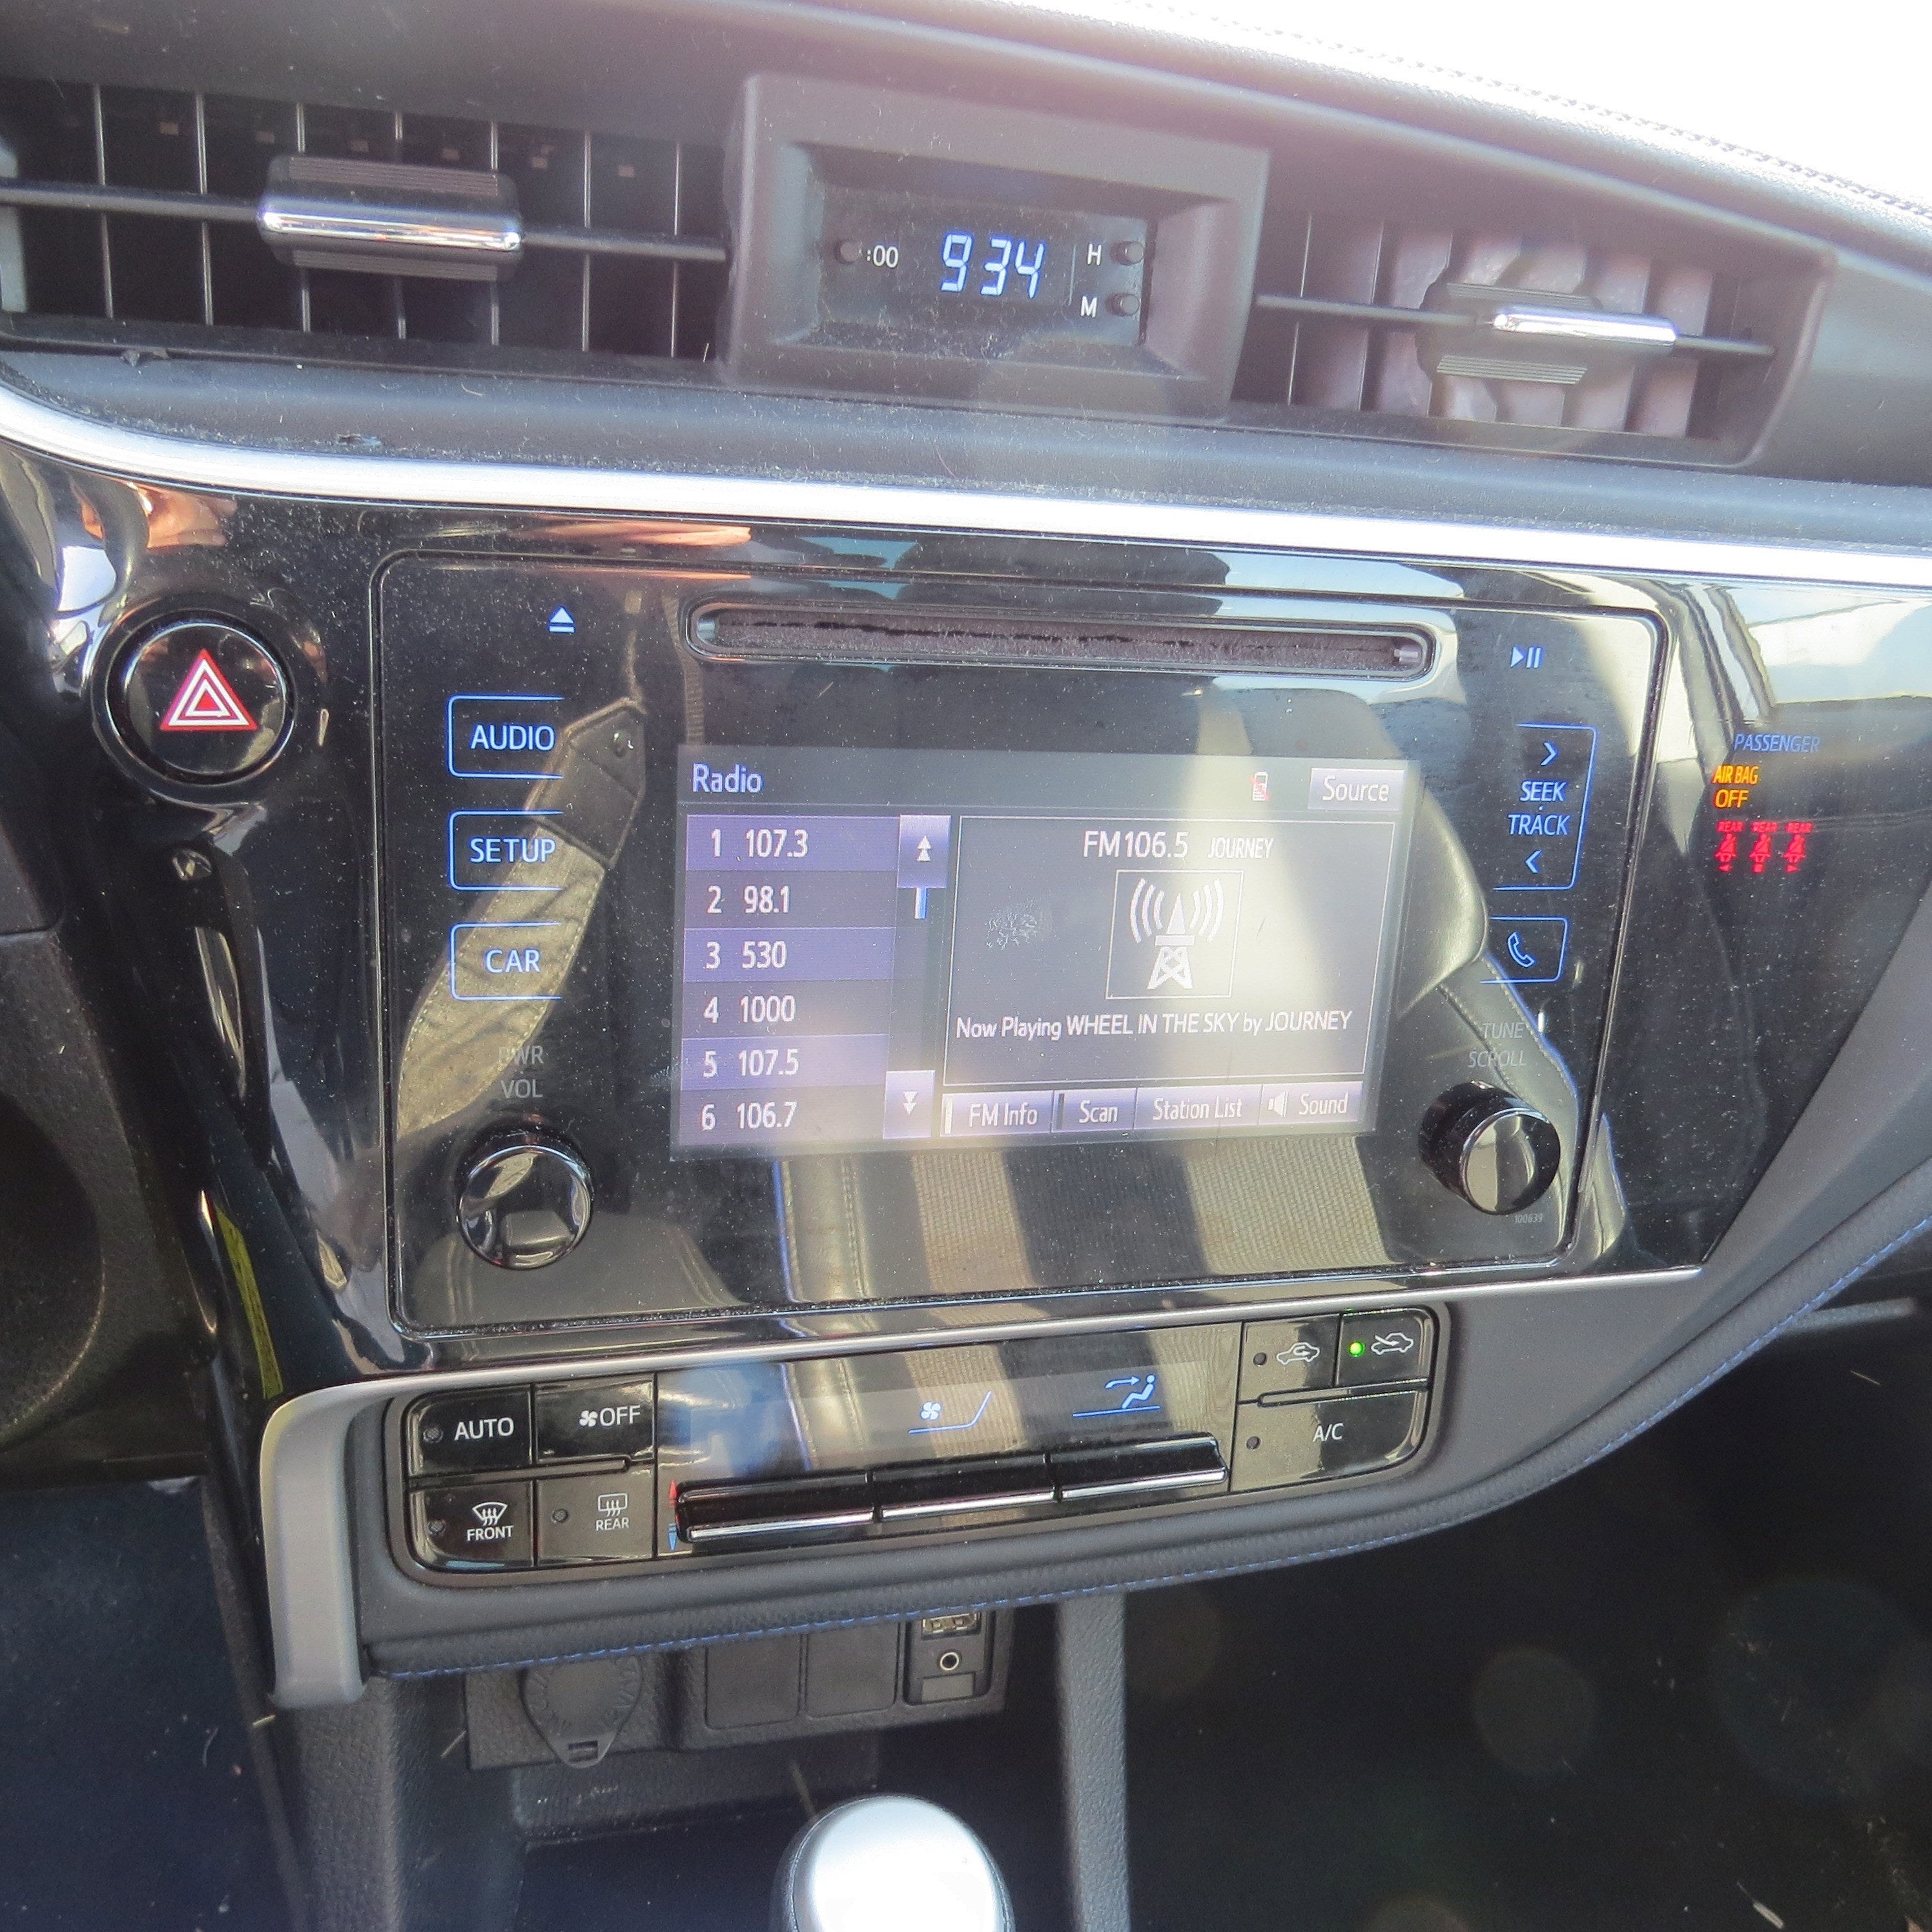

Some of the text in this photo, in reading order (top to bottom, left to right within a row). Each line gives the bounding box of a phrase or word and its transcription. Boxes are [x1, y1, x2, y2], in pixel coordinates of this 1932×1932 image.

[866, 244, 899, 268] :00
[1087, 243, 1102, 265] H
[1080, 296, 1097, 318] M
[470, 724, 555, 751] AUDIO
[1734, 734, 1821, 752] PASSENGER
[692, 763, 764, 793] Radio
[1712, 765, 1760, 785] AIR BAG
[1322, 774, 1390, 802] Source
[1519, 780, 1567, 802] SEEK
[1714, 789, 1749, 808] OFF
[1508, 814, 1570, 836] TRACK
[470, 838, 556, 863] SETUP
[711, 828, 808, 858] 1 107.3
[1208, 837, 1274, 859] JOURNEY
[707, 885, 790, 914] 2 98.1
[485, 949, 542, 974] CAR
[705, 941, 788, 970] 3 530
[703, 995, 797, 1023] 4 1000
[956, 1010, 1353, 1042] Now Playing WHEEL IN THE SKY by JOURNEY
[1482, 1022, 1525, 1039] TUNE
[702, 1049, 799, 1078] 5 107.5
[1467, 1049, 1527, 1068] SCROLL
[500, 1078, 544, 1098] VOL
[969, 1102, 1038, 1128] FM Info
[1078, 1099, 1119, 1124] Scan
[1152, 1095, 1244, 1121] Station List
[1298, 1091, 1350, 1116] Sound
[700, 1101, 797, 1131] 6 106.7
[599, 1404, 641, 1428] OFF
[454, 1417, 515, 1441] AUTO
[1312, 1423, 1344, 1443] A/C
[466, 1525, 514, 1542] FRONT
[595, 1517, 630, 1532] REAR
